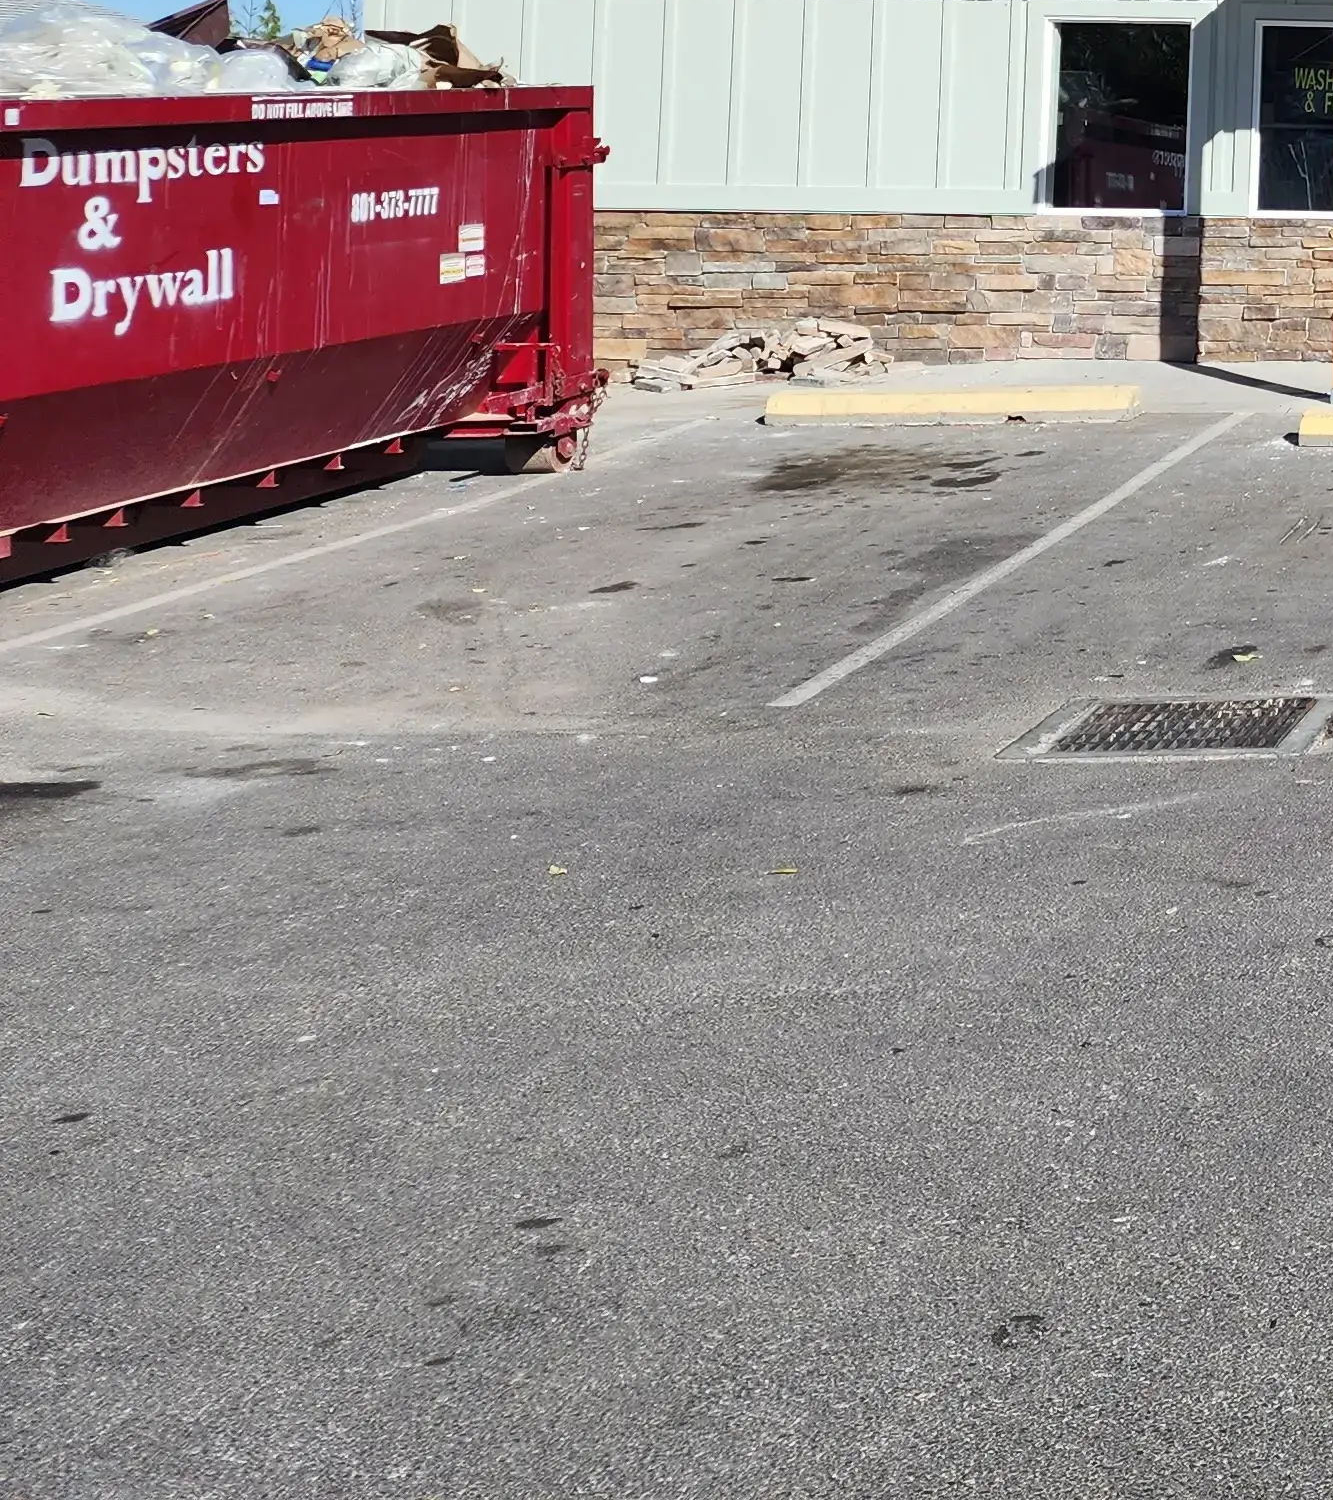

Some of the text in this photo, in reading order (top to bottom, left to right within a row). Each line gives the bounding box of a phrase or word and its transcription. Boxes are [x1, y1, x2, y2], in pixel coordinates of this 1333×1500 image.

[252, 103, 265, 119] DO
[267, 103, 285, 119] NOT
[286, 102, 304, 118] FILL
[305, 102, 332, 118] ABOVE
[1304, 91, 1316, 113] &
[19, 135, 265, 203] Dumpsters
[78, 196, 121, 250] &
[351, 187, 439, 222] 801-373-7777
[50, 248, 233, 336] Drywall
